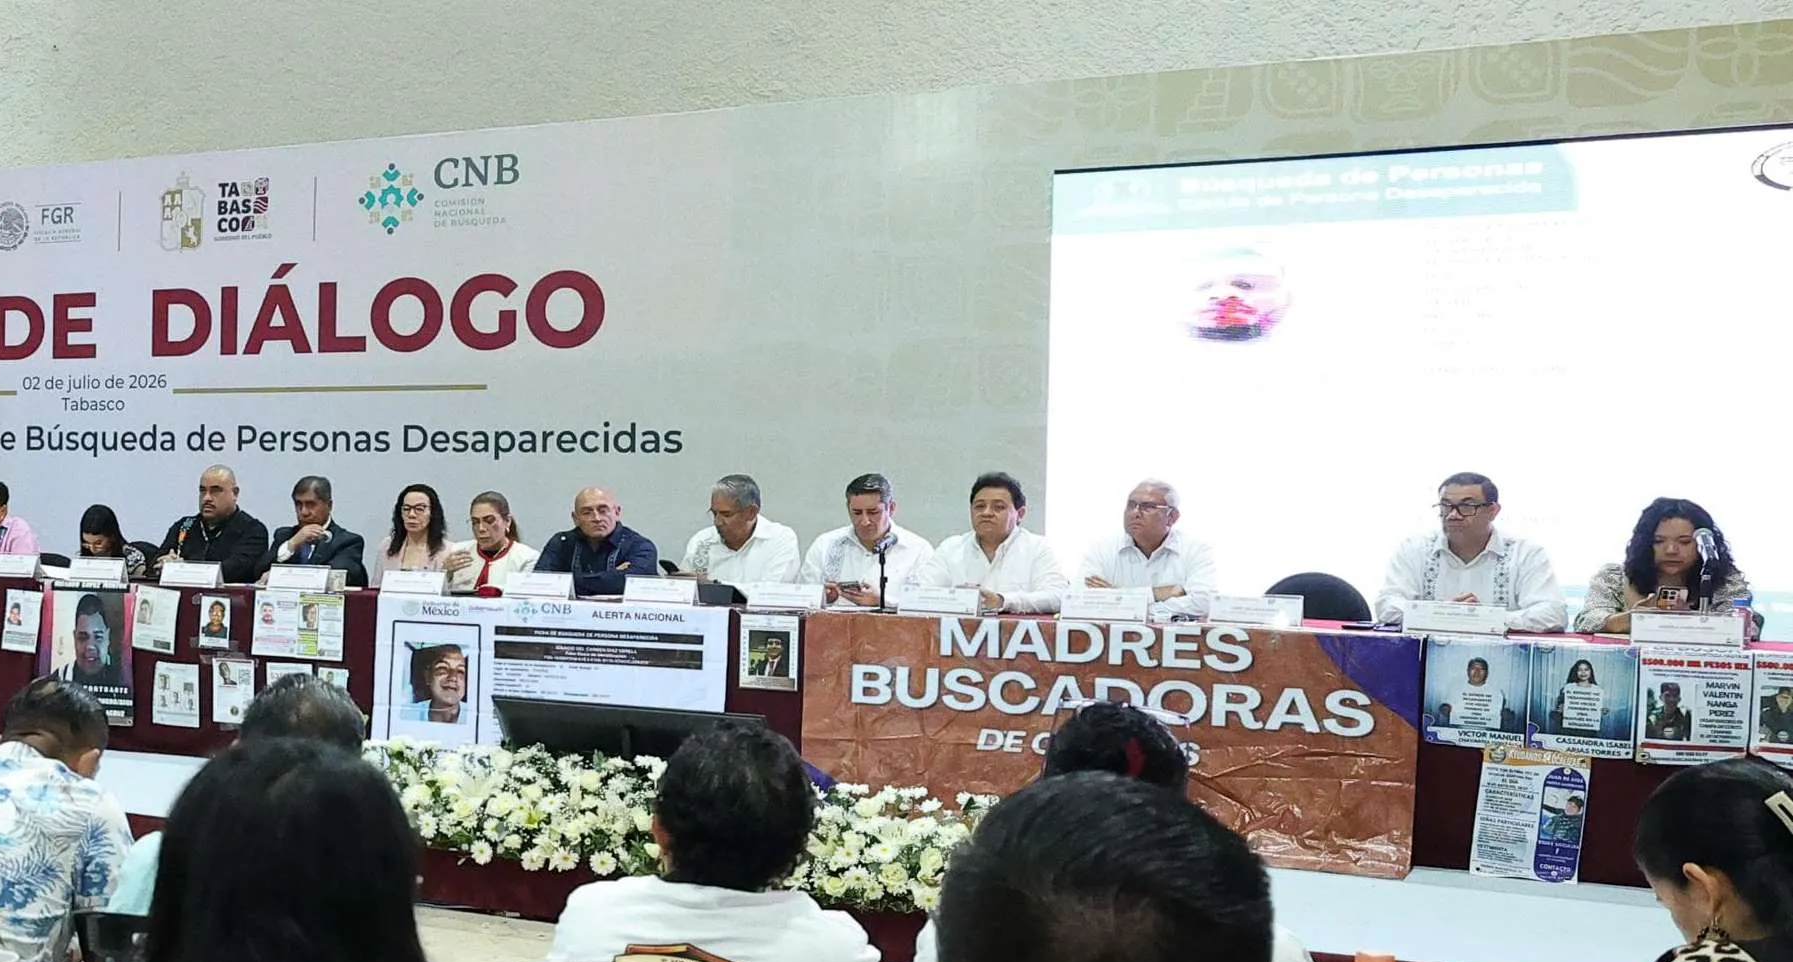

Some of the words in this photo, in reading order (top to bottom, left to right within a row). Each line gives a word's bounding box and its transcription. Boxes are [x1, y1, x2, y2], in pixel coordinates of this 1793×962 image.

[434, 153, 520, 190] CNB
[218, 182, 240, 198] TA
[217, 198, 252, 216] BAS
[433, 207, 486, 217] NACIONAL
[41, 206, 75, 225] FGR
[217, 217, 240, 233] CO
[433, 220, 448, 228] DE
[151, 262, 606, 357] DIÁLOGO
[22, 376, 40, 391] 02
[44, 374, 64, 391] de
[67, 374, 101, 394] julio
[104, 374, 125, 391] de
[127, 373, 168, 390] 2026
[61, 396, 126, 412] Tabasco
[25, 423, 176, 457] Búsqueda
[186, 424, 226, 452] de
[237, 425, 391, 454] Personas
[403, 421, 683, 460] Desaparecidas
[421, 604, 460, 617] México
[540, 602, 573, 616] CNB
[591, 610, 632, 621] ALERTA
[634, 612, 686, 623] NACIONAL
[939, 617, 1254, 673] MADRES
[1703, 660, 1733, 669] PESOS
[1705, 682, 1741, 690] MARVIN
[849, 662, 1377, 738] BUSCADORAS
[1702, 690, 1744, 700] VALENTIN
[976, 728, 1028, 753] DE
[1555, 737, 1604, 748] CASSANDRA
[1605, 739, 1632, 749] ISABEL
[1592, 747, 1622, 757] TORRES
